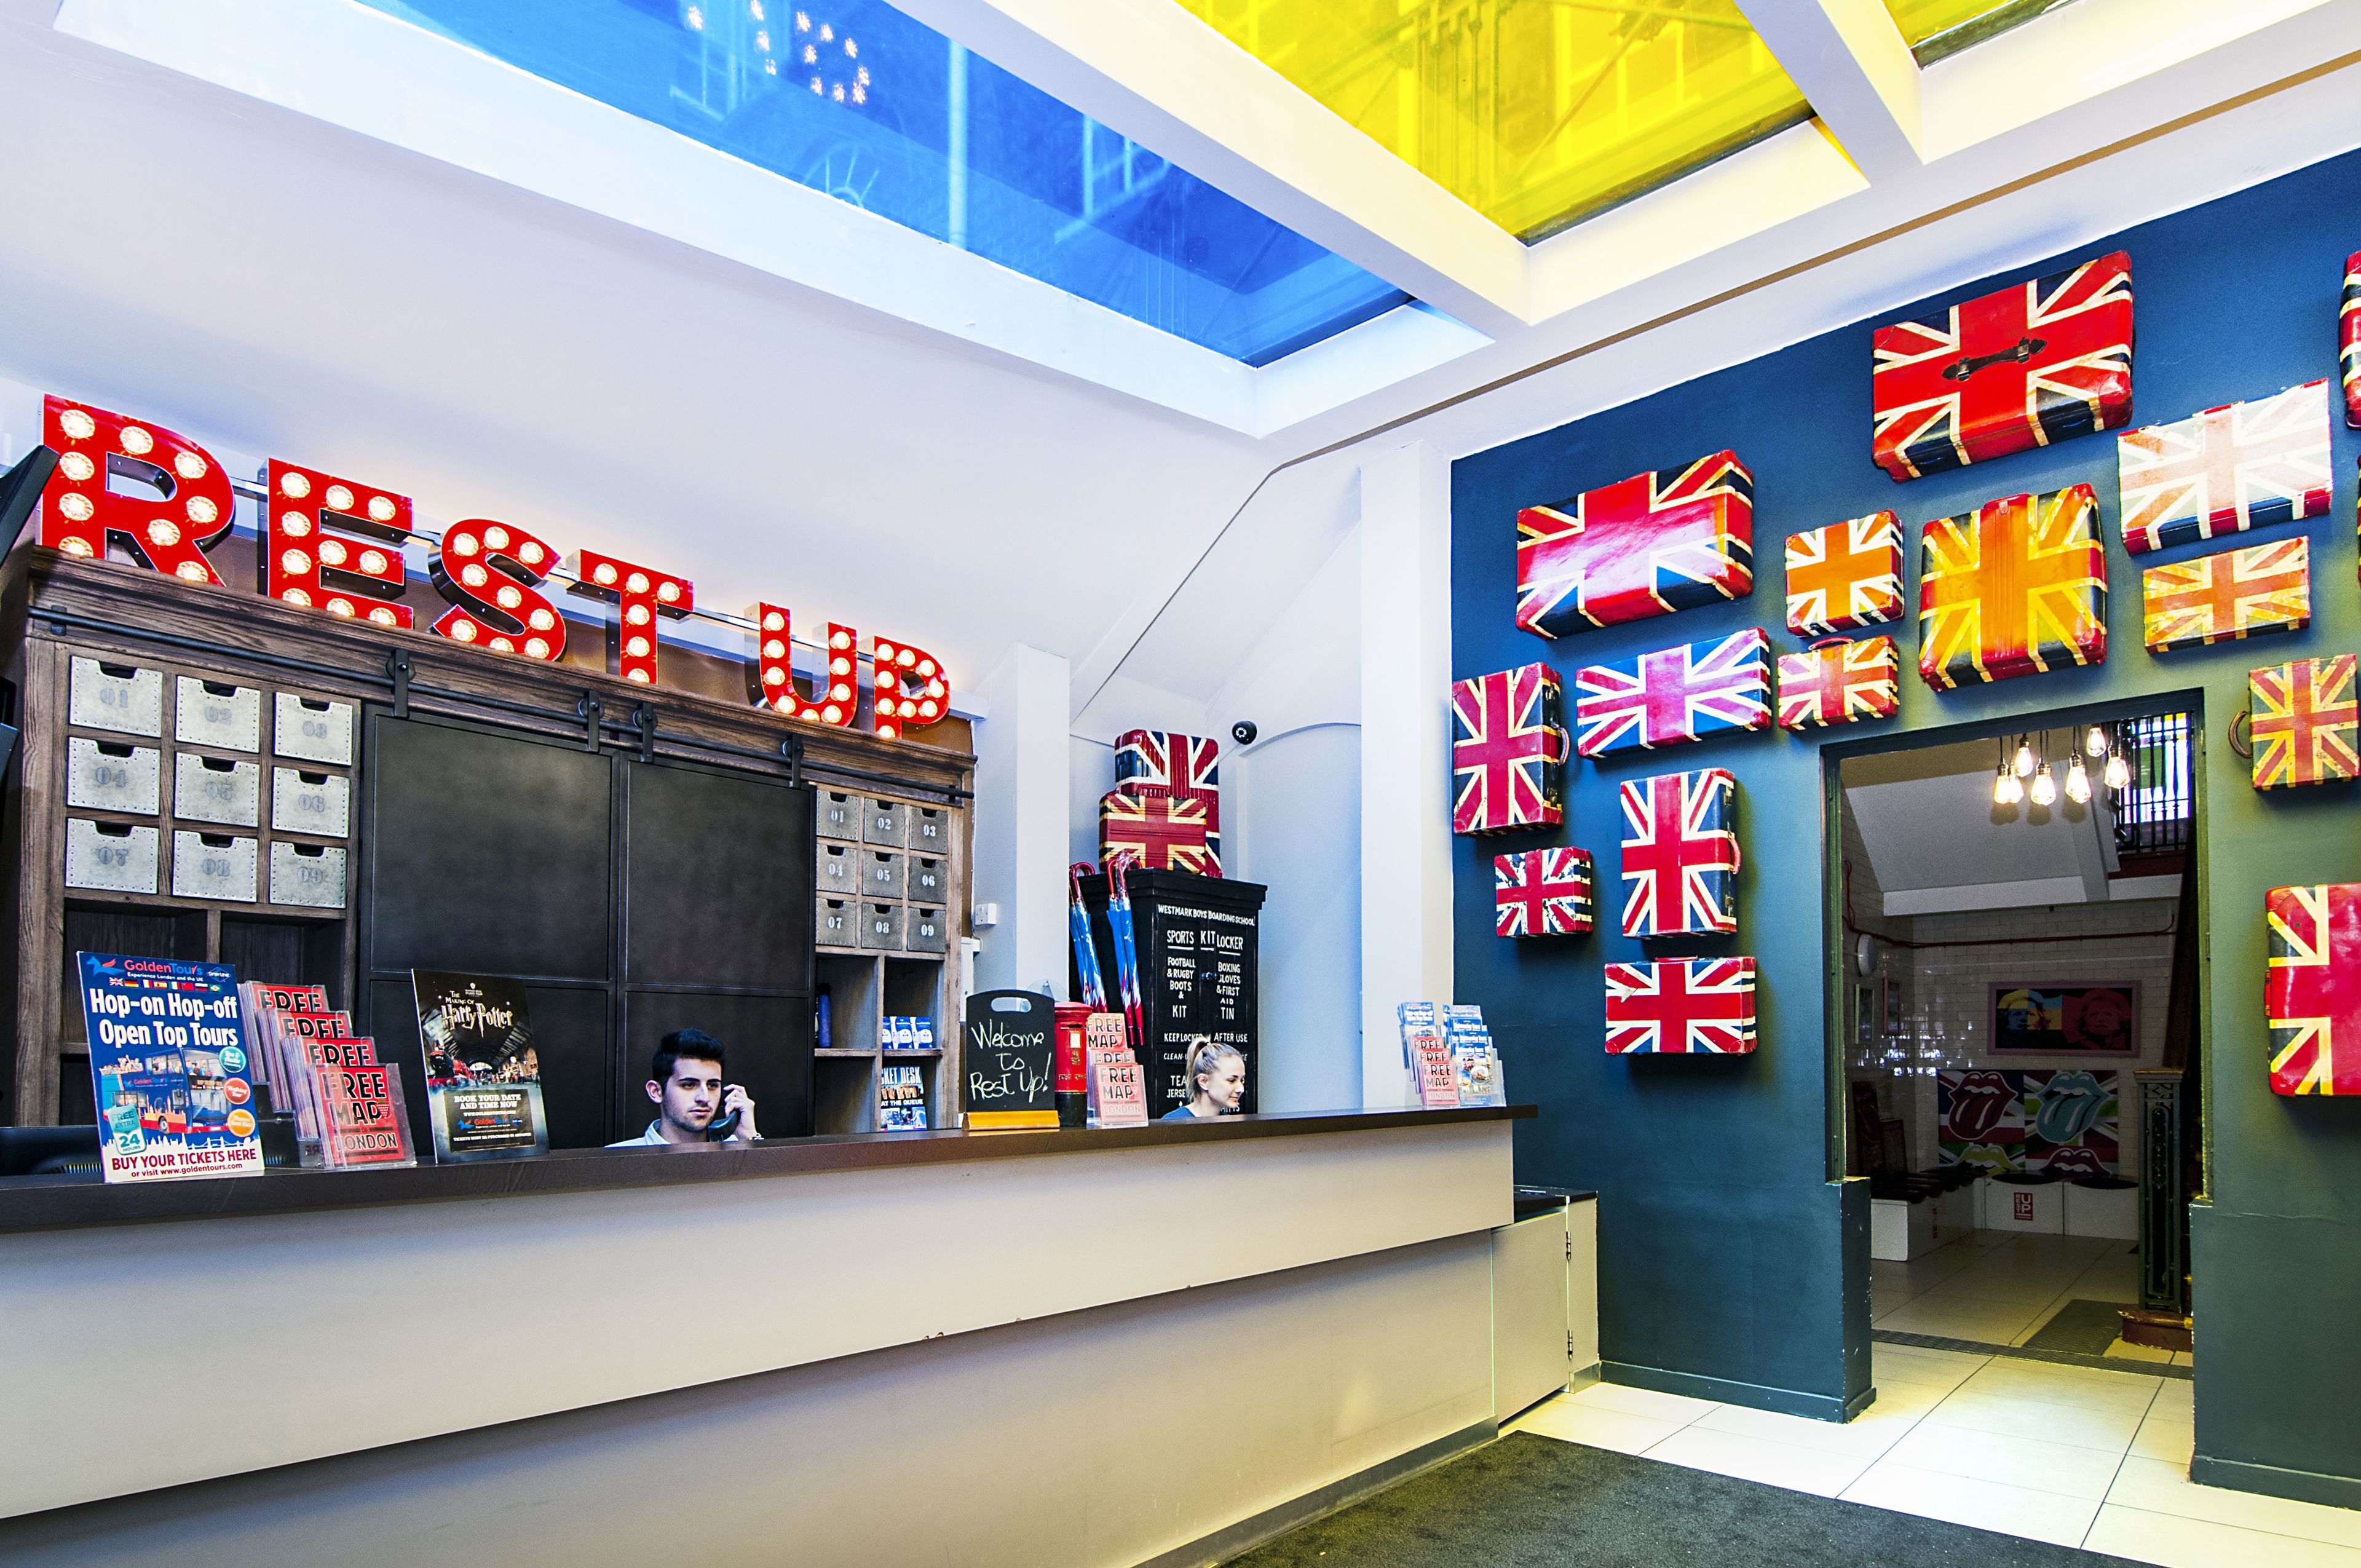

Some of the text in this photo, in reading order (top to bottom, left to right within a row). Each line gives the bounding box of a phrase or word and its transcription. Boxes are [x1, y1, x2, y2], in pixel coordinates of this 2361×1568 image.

[41, 394, 951, 738] REST UP
[100, 687, 128, 708] 01
[204, 706, 232, 725] 02
[302, 721, 327, 738] 03
[95, 767, 127, 787] 04
[205, 782, 232, 800] 05
[298, 794, 325, 812] 06
[831, 810, 844, 823] 01
[878, 817, 891, 830] 02
[923, 825, 936, 837] 03
[98, 847, 129, 866] 07
[202, 858, 230, 877] 08
[829, 863, 842, 876] 04
[297, 866, 323, 884] 09
[877, 869, 890, 881] 05
[922, 875, 935, 887] 06
[1158, 904, 1255, 926] WESTMARK BOYS BOARDING SCHOOL
[828, 917, 842, 929] 07
[876, 922, 889, 933] 08
[921, 924, 934, 936] 09
[1167, 930, 1243, 950] SPORTS KIT LOCKER
[124, 959, 202, 975] GoldenTours
[1168, 957, 1196, 968] FOOTBALL
[1218, 962, 1240, 973] BOXING
[1169, 980, 1192, 991] BOOTS
[89, 988, 237, 1021] Hop-on Hop-off
[1173, 1005, 1187, 1018] KIT
[441, 1003, 513, 1038] Harry Potter
[1221, 1007, 1235, 1020] TIN
[1087, 1018, 1121, 1032] FREE
[100, 1019, 239, 1048] Open Top Tours
[971, 1019, 1044, 1049] Welcome
[1164, 1032, 1180, 1042] KEEP
[1214, 1032, 1234, 1042] AFTER
[1236, 1034, 1248, 1043] USE
[1088, 1035, 1117, 1048] MAP
[900, 1066, 921, 1083] DESK
[1101, 1067, 1137, 1083] FREE
[1424, 1064, 1451, 1075] FREE
[1020, 1052, 1051, 1103] Up!
[1170, 1075, 1187, 1086] TEA
[1426, 1078, 1449, 1087] MAP
[321, 1072, 387, 1099] FREE
[970, 1072, 1015, 1101] Rest
[1103, 1085, 1133, 1099] MAP
[1166, 1088, 1188, 1098] JERSE
[111, 1111, 135, 1121] FREE
[329, 1101, 382, 1126] MAP
[1105, 1104, 1141, 1114] LONDON
[119, 1134, 140, 1147] 24
[112, 1149, 256, 1170] BUY YOUR TICKETS HERE
[160, 1163, 243, 1175] www.goldentours.com
